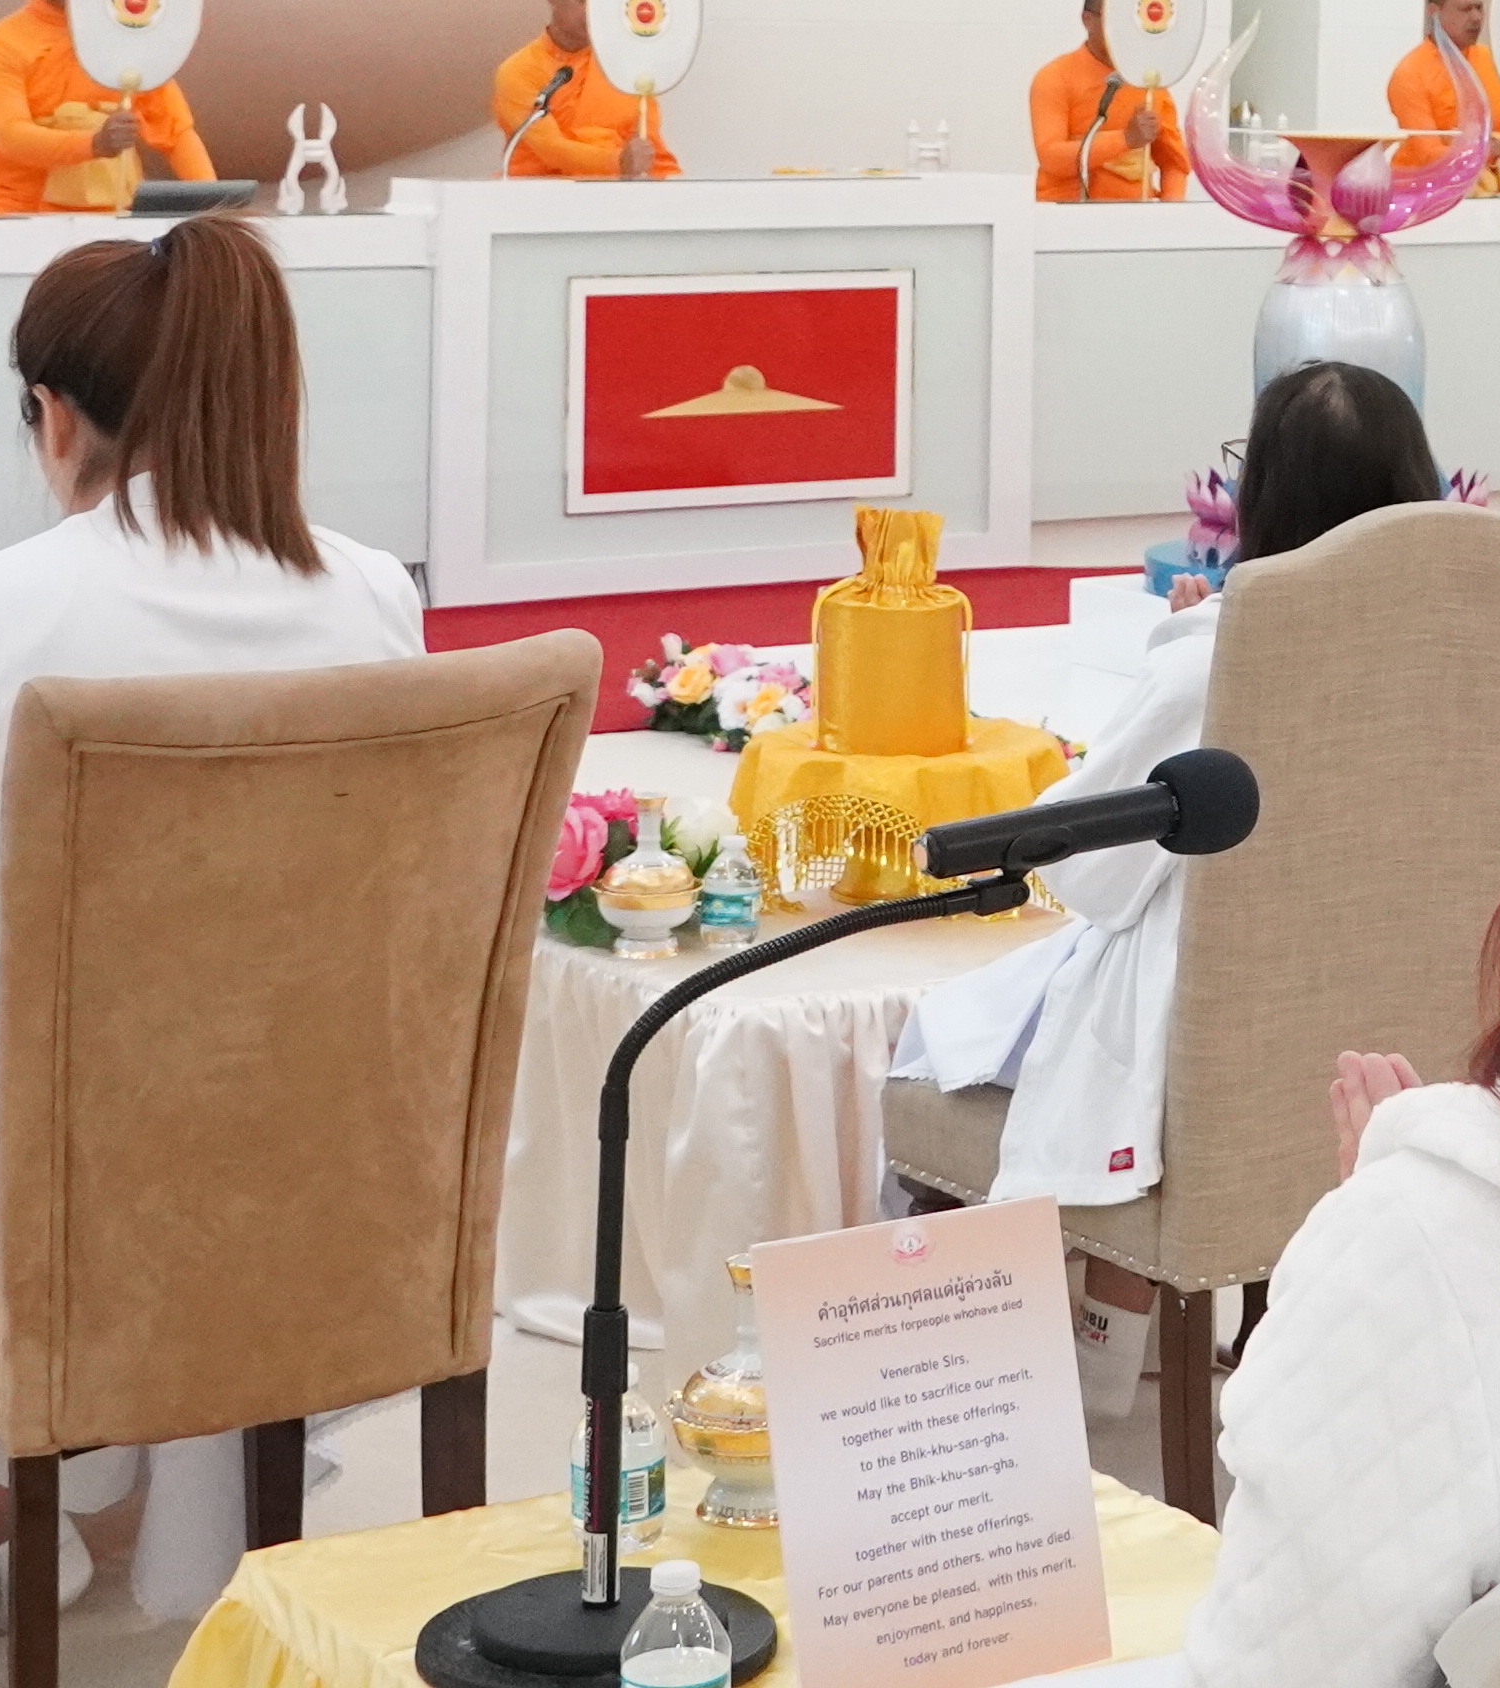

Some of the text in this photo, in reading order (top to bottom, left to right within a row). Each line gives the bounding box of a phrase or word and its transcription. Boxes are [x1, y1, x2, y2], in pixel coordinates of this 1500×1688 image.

[813, 1328, 860, 1349] Sacrifice
[864, 1322, 897, 1339] merits
[1001, 1298, 1023, 1312] died
[880, 1357, 939, 1380] Venerable
[820, 1409, 837, 1421] we
[841, 1400, 877, 1417] would
[880, 1393, 901, 1410] like
[905, 1392, 917, 1405] to
[921, 1381, 971, 1402] sacrifice
[975, 1378, 995, 1390] our
[842, 1425, 894, 1448] together
[898, 1420, 923, 1436] with
[927, 1414, 960, 1430] these
[860, 1460, 873, 1472] to
[877, 1455, 896, 1469] the
[857, 1488, 882, 1502] May
[887, 1482, 906, 1496] the
[890, 1505, 930, 1525] accept
[933, 1502, 954, 1515] our
[855, 1540, 907, 1562] together
[911, 1534, 937, 1548] with
[940, 1526, 974, 1542] these
[818, 1585, 838, 1600] For
[843, 1581, 863, 1594] our
[867, 1569, 913, 1591] parents
[917, 1562, 939, 1577] and
[988, 1545, 1013, 1560] who
[1015, 1538, 1043, 1554] have
[823, 1614, 849, 1629] May
[853, 1598, 910, 1622] everyone
[913, 1594, 928, 1607] be
[988, 1573, 1013, 1589] with
[1016, 1566, 1039, 1582] this
[949, 1612, 971, 1627] and
[903, 1650, 938, 1668] today
[941, 1643, 964, 1658] and
